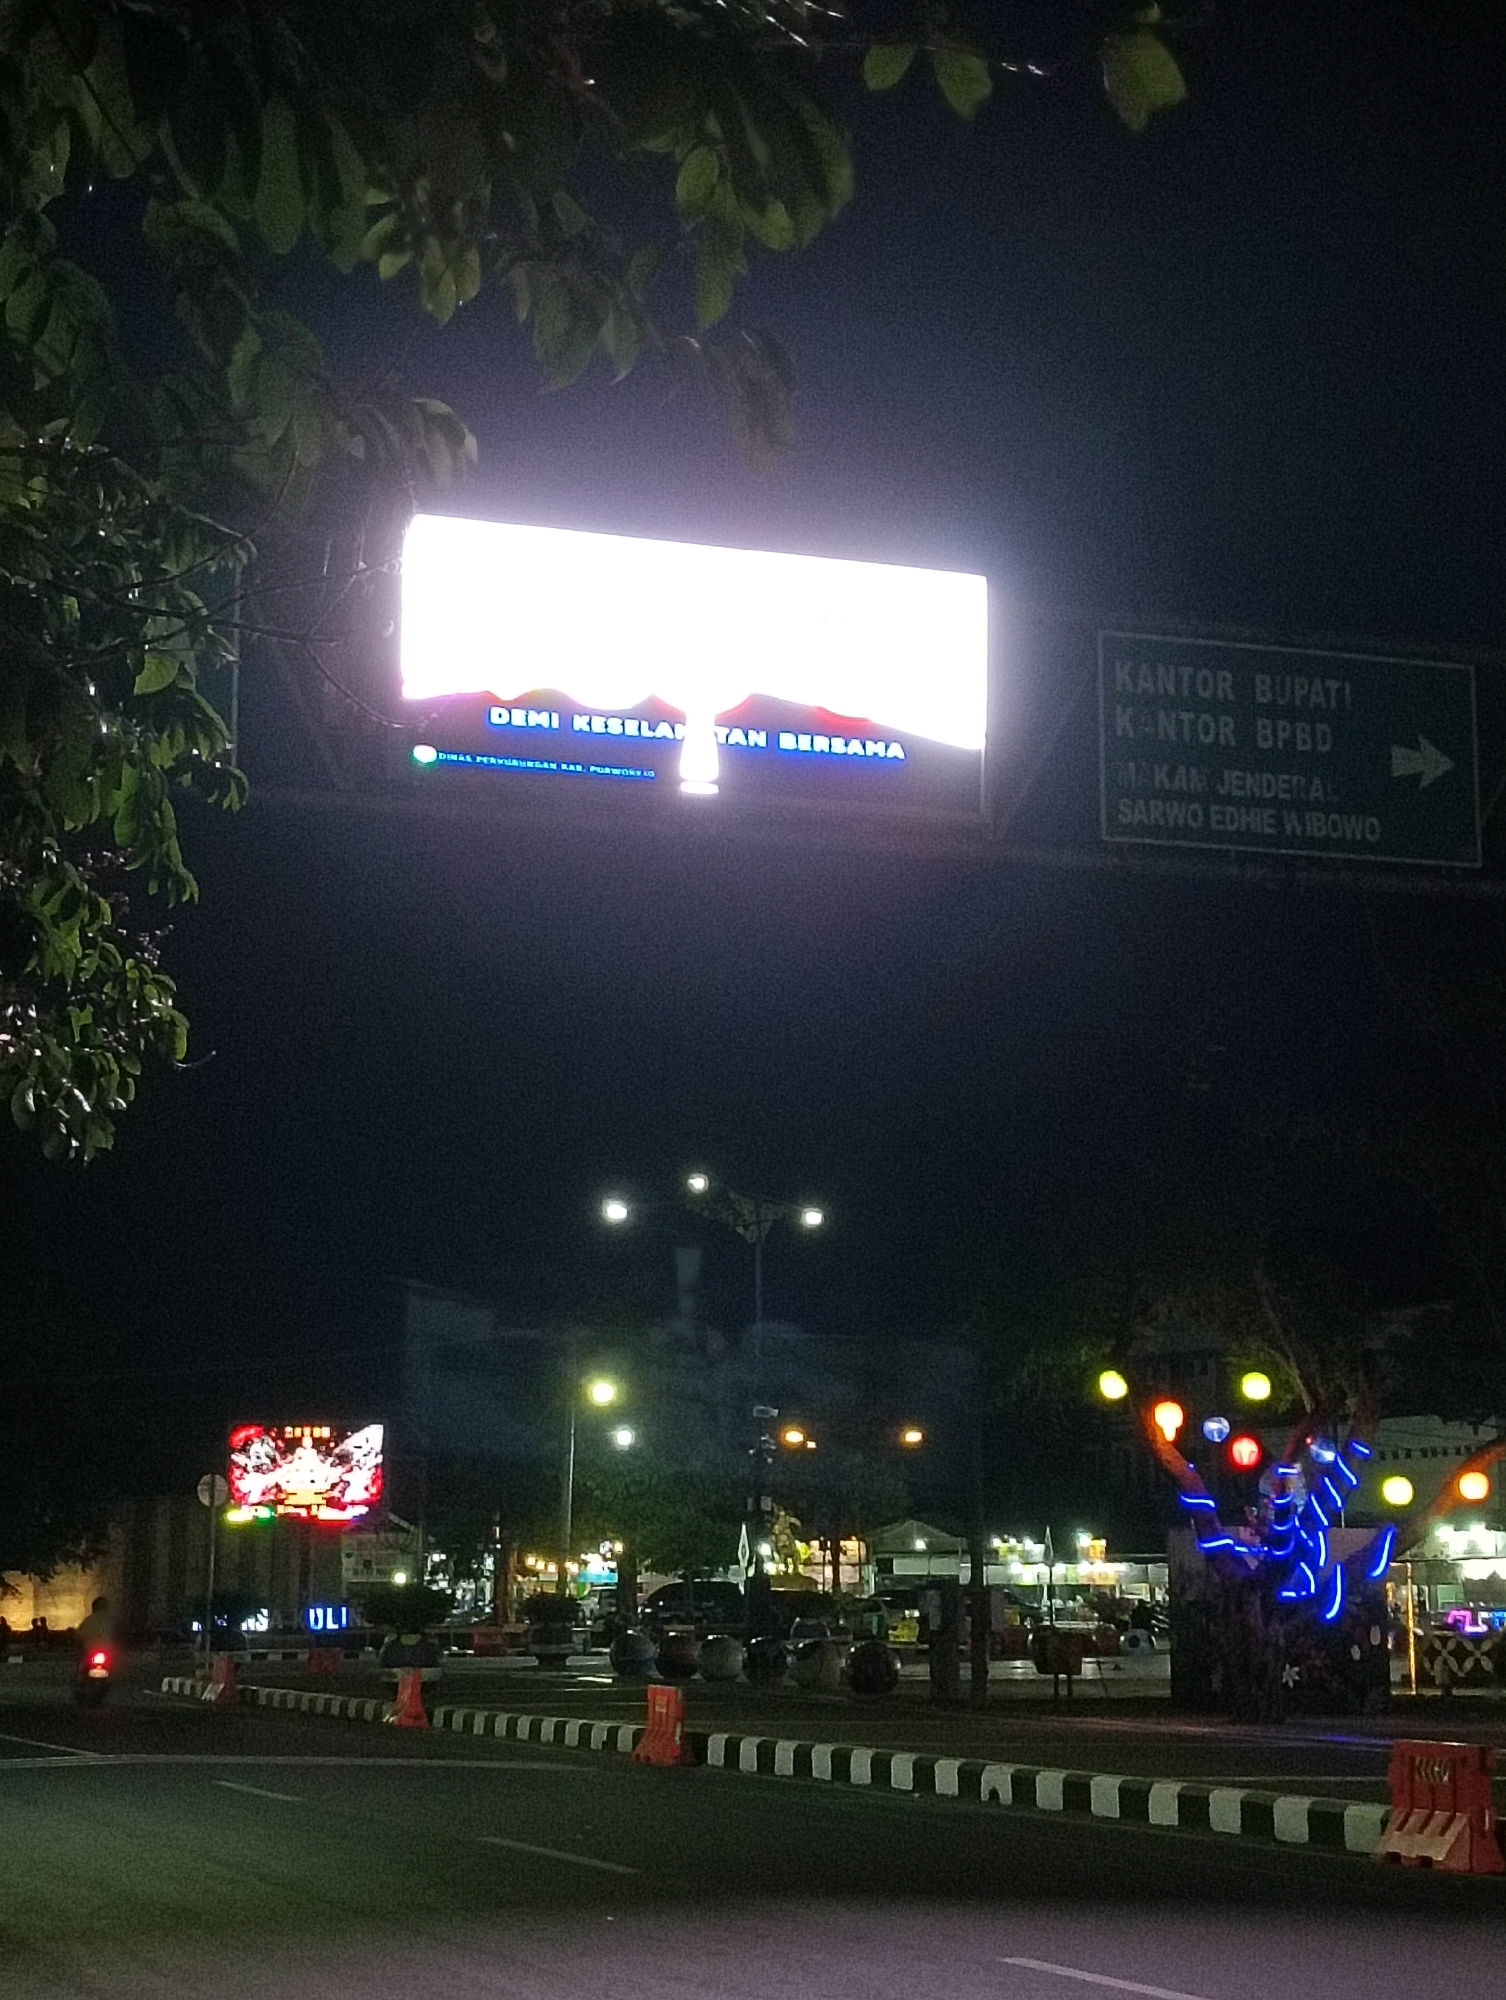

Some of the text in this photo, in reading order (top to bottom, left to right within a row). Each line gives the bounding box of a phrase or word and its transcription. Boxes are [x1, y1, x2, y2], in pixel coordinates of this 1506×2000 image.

[1115, 659, 1351, 712] KANTOR BUPATI
[490, 706, 560, 729] DEMI
[779, 731, 906, 760] BERSAMA
[1256, 717, 1333, 753] BPBD
[1118, 798, 1381, 844] SARWO EDHIE WIBOWO
